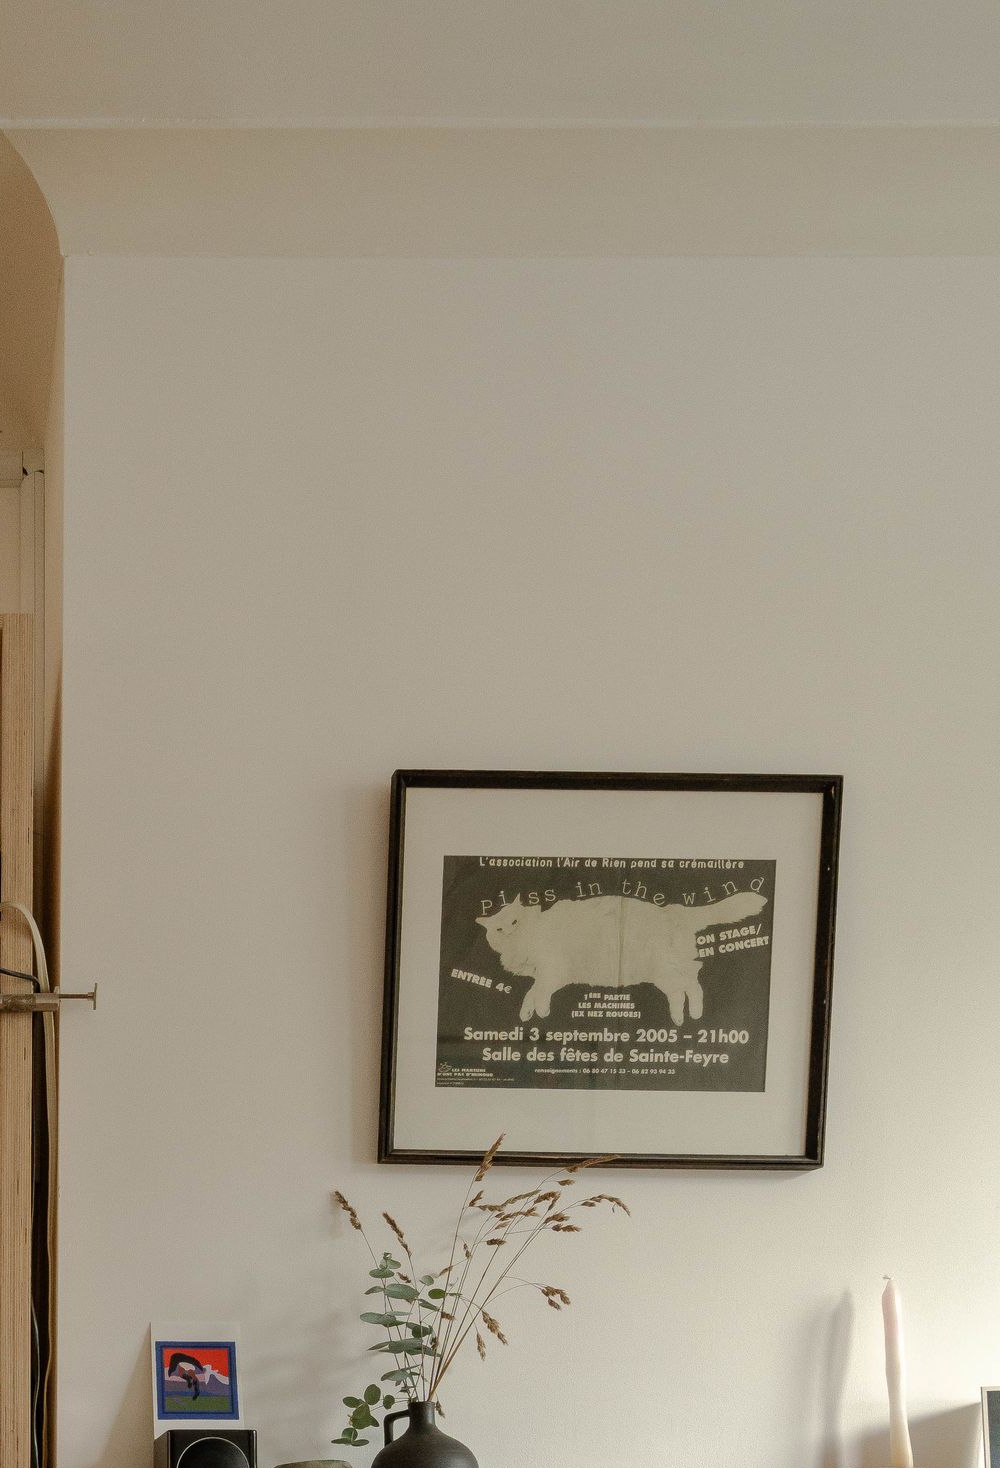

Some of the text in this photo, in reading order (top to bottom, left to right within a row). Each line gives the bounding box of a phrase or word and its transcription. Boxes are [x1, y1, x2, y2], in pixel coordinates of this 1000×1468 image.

[480, 857, 552, 868] L'association
[557, 857, 580, 868] l'Air
[585, 858, 597, 868] de
[602, 858, 626, 868] Rien
[630, 859, 656, 869] pend
[480, 876, 765, 916] piss in the wind
[696, 934, 715, 945] ON
[698, 935, 770, 958] EN CONCERT
[495, 982, 512, 994] 4€
[464, 1026, 523, 1041] Samedi
[529, 1028, 540, 1041] 3
[546, 1028, 630, 1045] septembre
[636, 1028, 678, 1042] 2005
[698, 1029, 750, 1044] 21h00
[482, 1047, 729, 1067] Salle des fêtes de Sainte-Feyre
